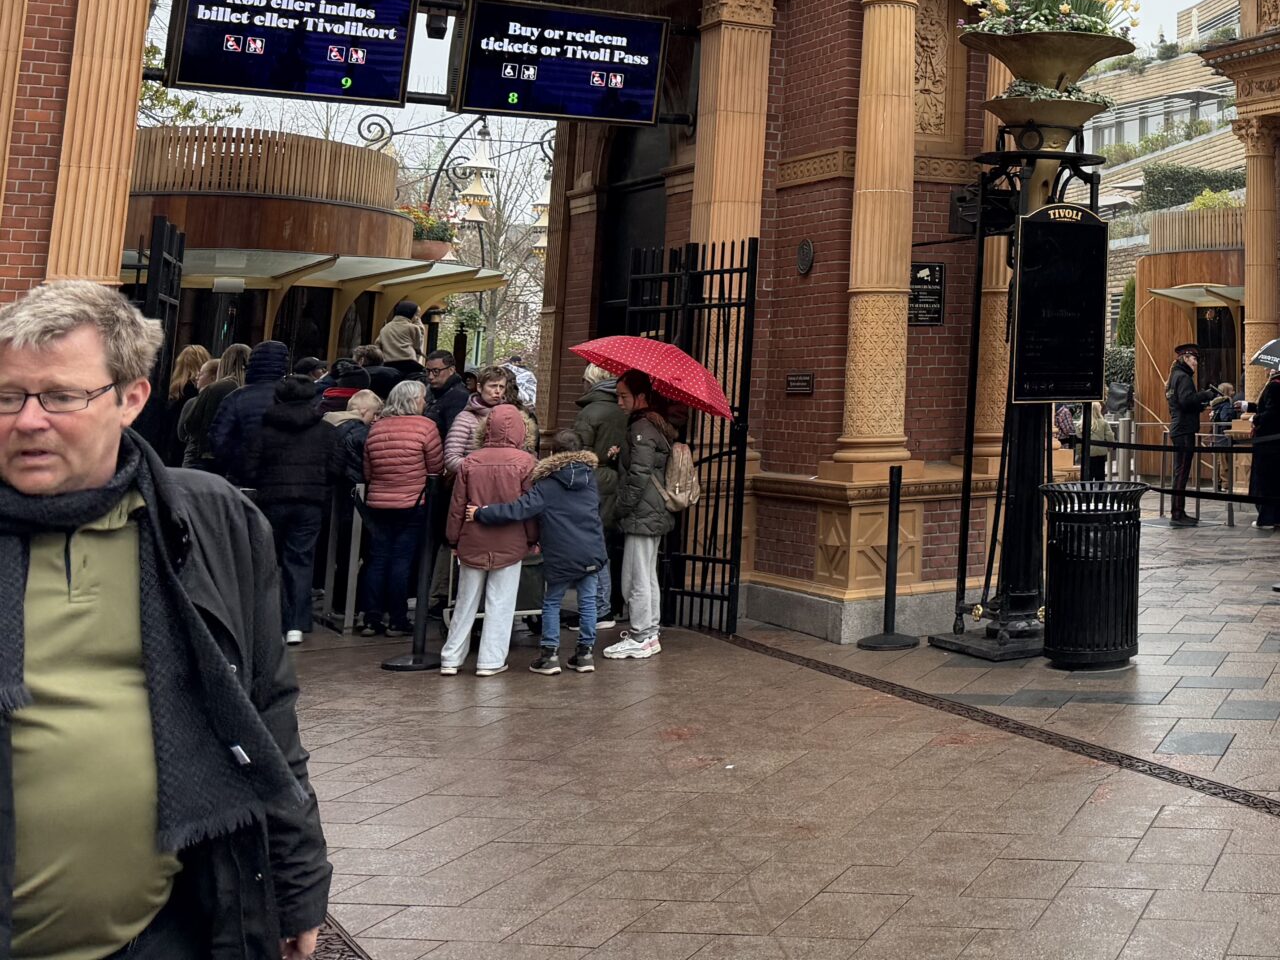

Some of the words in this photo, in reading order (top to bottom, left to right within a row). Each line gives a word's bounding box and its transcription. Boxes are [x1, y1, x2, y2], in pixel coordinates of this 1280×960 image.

[318, 0, 376, 20] indløs
[197, 5, 251, 24] billet
[253, 12, 300, 30] eller
[302, 17, 398, 41] Tivolikort
[508, 21, 542, 41] Buy
[543, 28, 564, 40] or
[566, 30, 627, 47] redeem
[480, 36, 538, 55] tickets
[540, 44, 561, 57] or
[563, 45, 610, 63] Tivoli
[612, 50, 649, 66] Pass
[341, 76, 352, 89] 9
[508, 91, 519, 104] 8
[1048, 208, 1083, 221] TIVOLI
